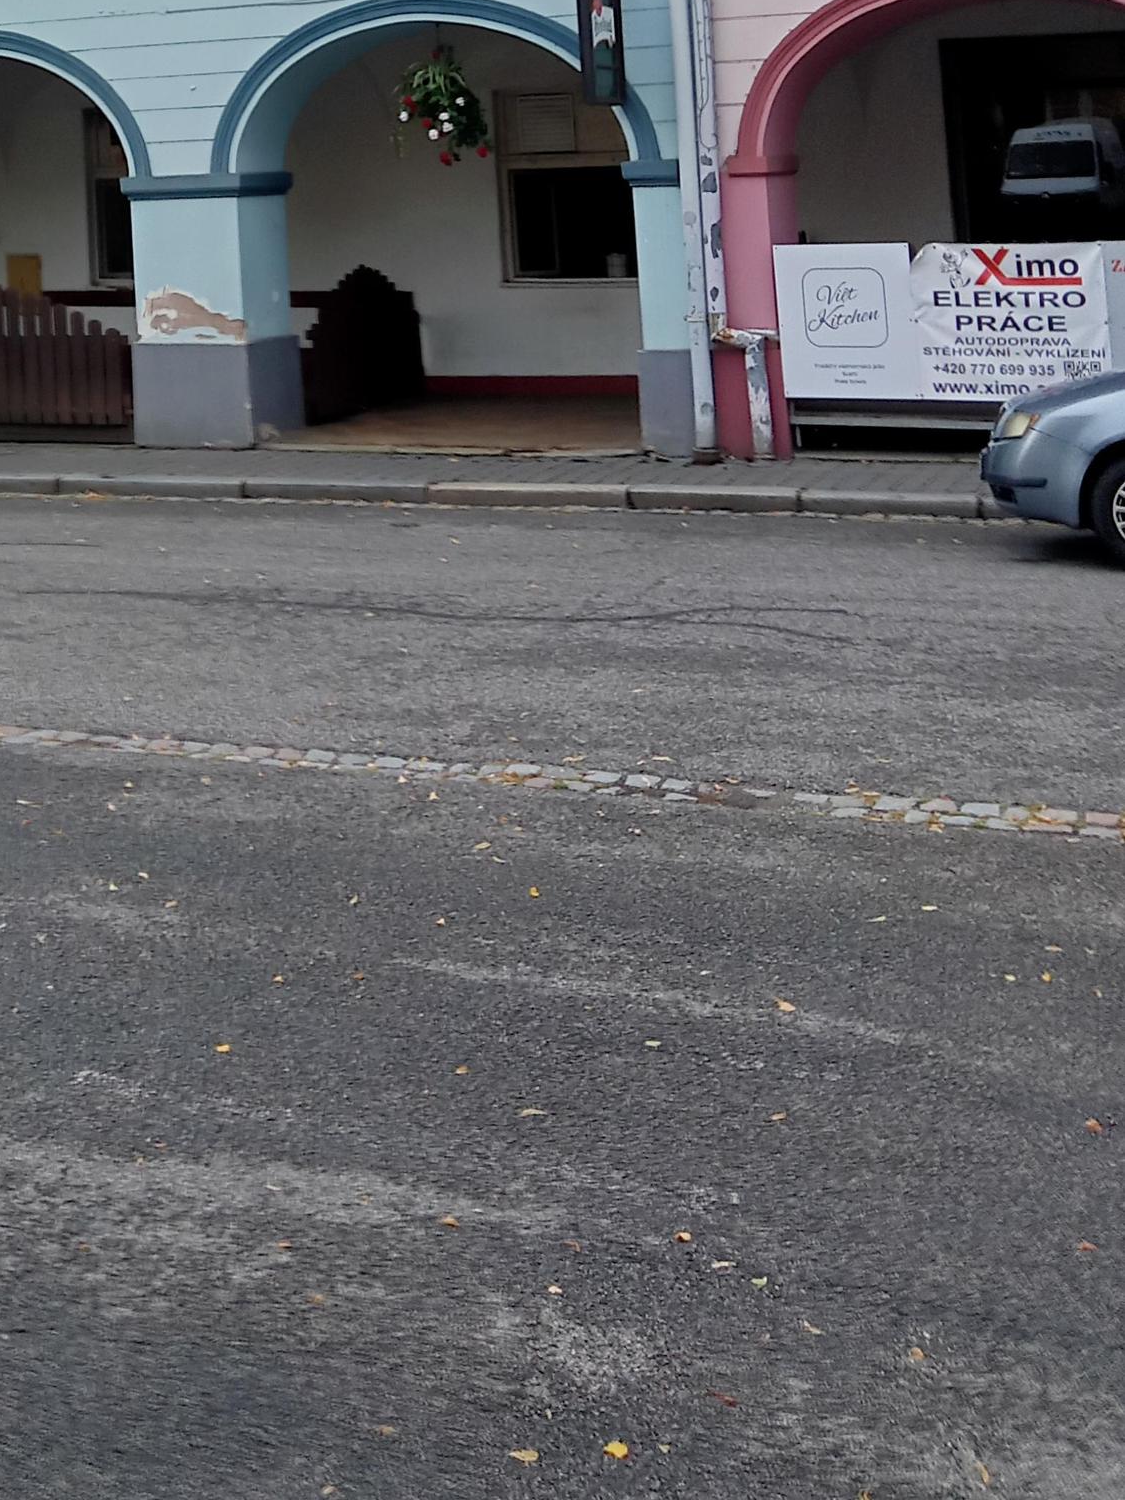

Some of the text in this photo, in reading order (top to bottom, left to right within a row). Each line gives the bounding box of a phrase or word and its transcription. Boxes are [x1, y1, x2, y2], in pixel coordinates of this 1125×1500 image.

[970, 246, 1082, 286] Ximo
[933, 290, 1086, 309] ELEKTRO
[808, 304, 879, 332] Kitchen
[955, 311, 1068, 333] PRÁCE
[954, 336, 1071, 347] AUTODOPRAVA
[923, 346, 1011, 358] STĚHOVÁNÍ
[1024, 347, 1106, 359] VYKLÍZENÍ
[932, 363, 1055, 377] +420 770 699 935
[932, 380, 1047, 396] www.ximo
